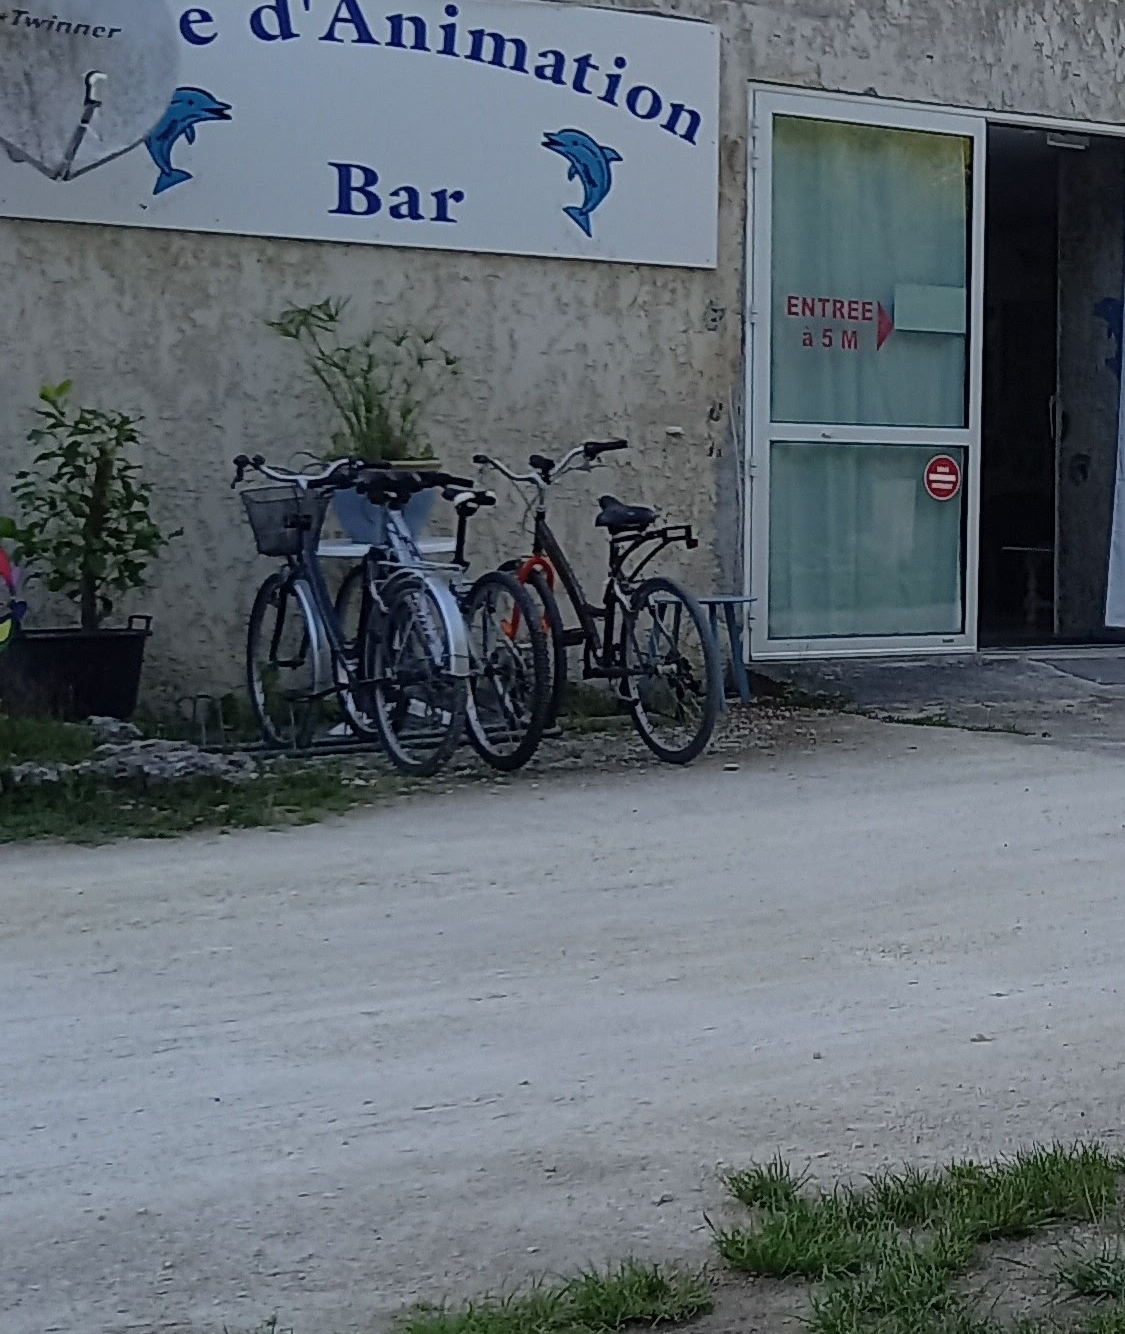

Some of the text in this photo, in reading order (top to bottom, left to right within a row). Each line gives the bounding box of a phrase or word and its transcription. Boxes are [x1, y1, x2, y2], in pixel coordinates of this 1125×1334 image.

[327, 161, 465, 223] Bar
[787, 295, 873, 321] ENTREE
[802, 326, 858, 350] à 5 M
